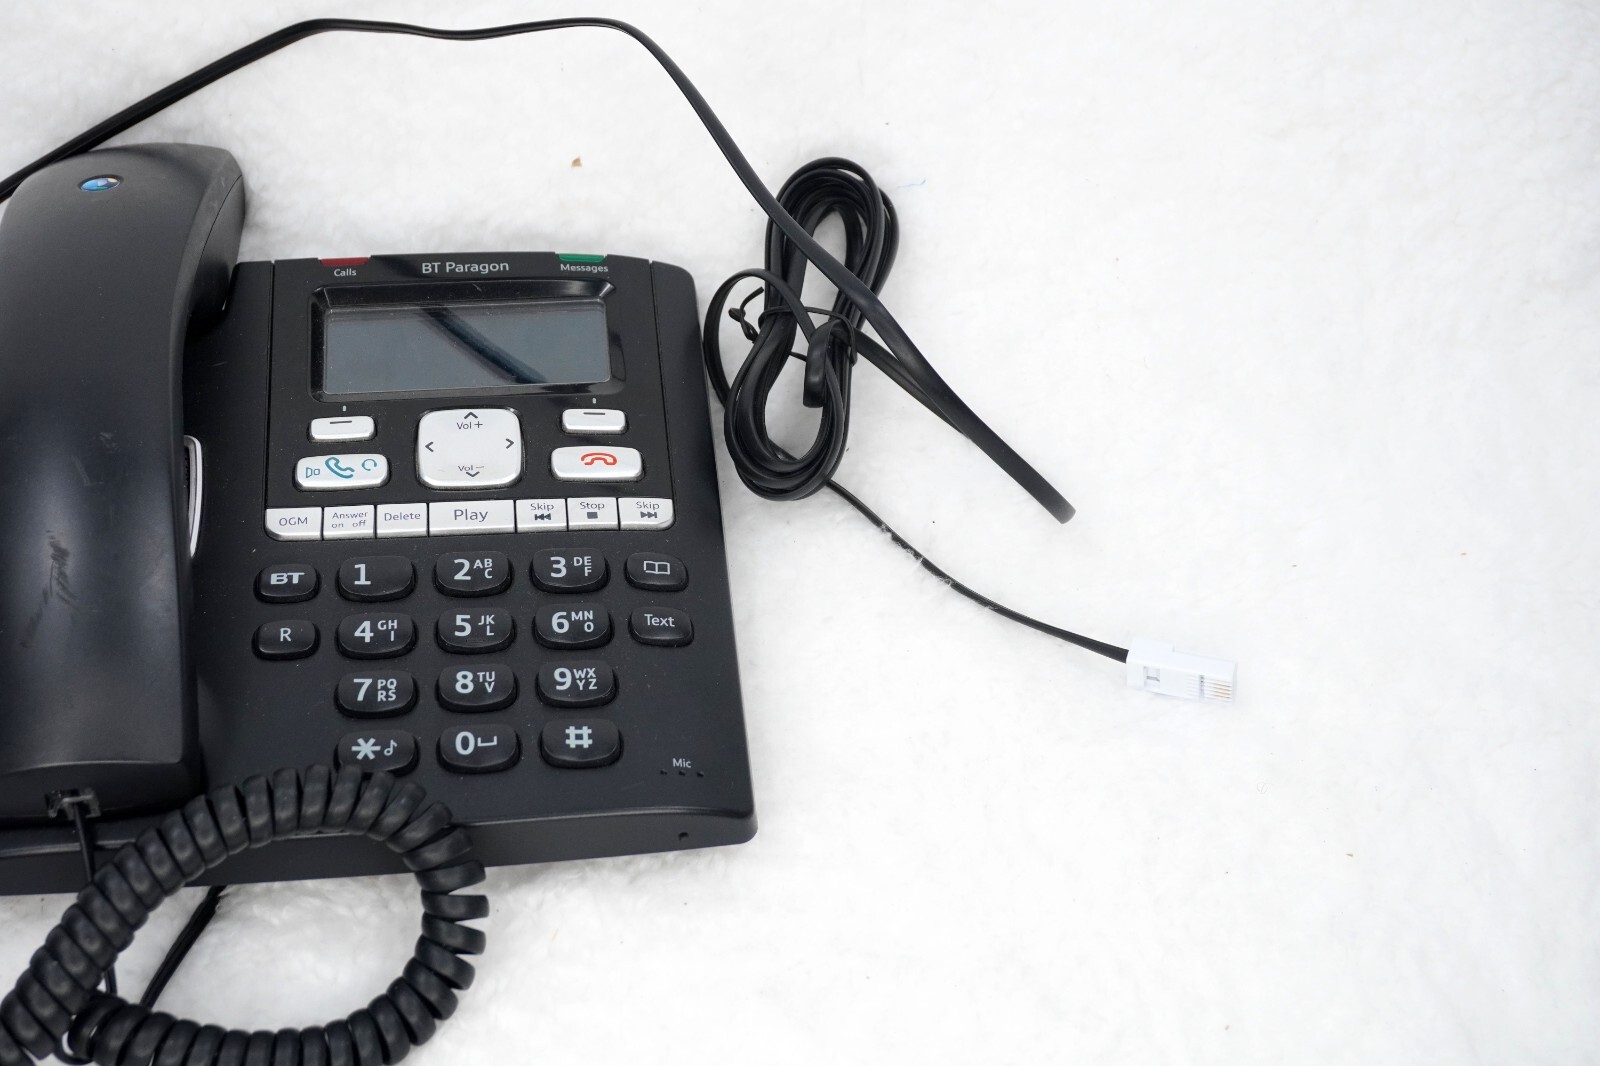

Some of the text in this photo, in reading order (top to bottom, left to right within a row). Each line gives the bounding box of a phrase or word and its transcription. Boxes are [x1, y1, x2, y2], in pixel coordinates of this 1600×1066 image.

[334, 268, 357, 277] Calls
[421, 260, 510, 274] BT Paragon
[560, 263, 609, 274] Messages
[530, 502, 554, 513] Skip
[580, 501, 605, 511] Stop
[636, 501, 660, 511] Skip
[332, 511, 368, 519] Answer
[384, 512, 421, 522] Delete
[454, 508, 488, 522] Play
[279, 516, 308, 526] OGM
[352, 519, 366, 528] off
[270, 572, 305, 585] BT
[354, 563, 371, 585] 1
[644, 613, 675, 628] Text
[280, 628, 292, 642] R
[672, 758, 692, 769] Mic
